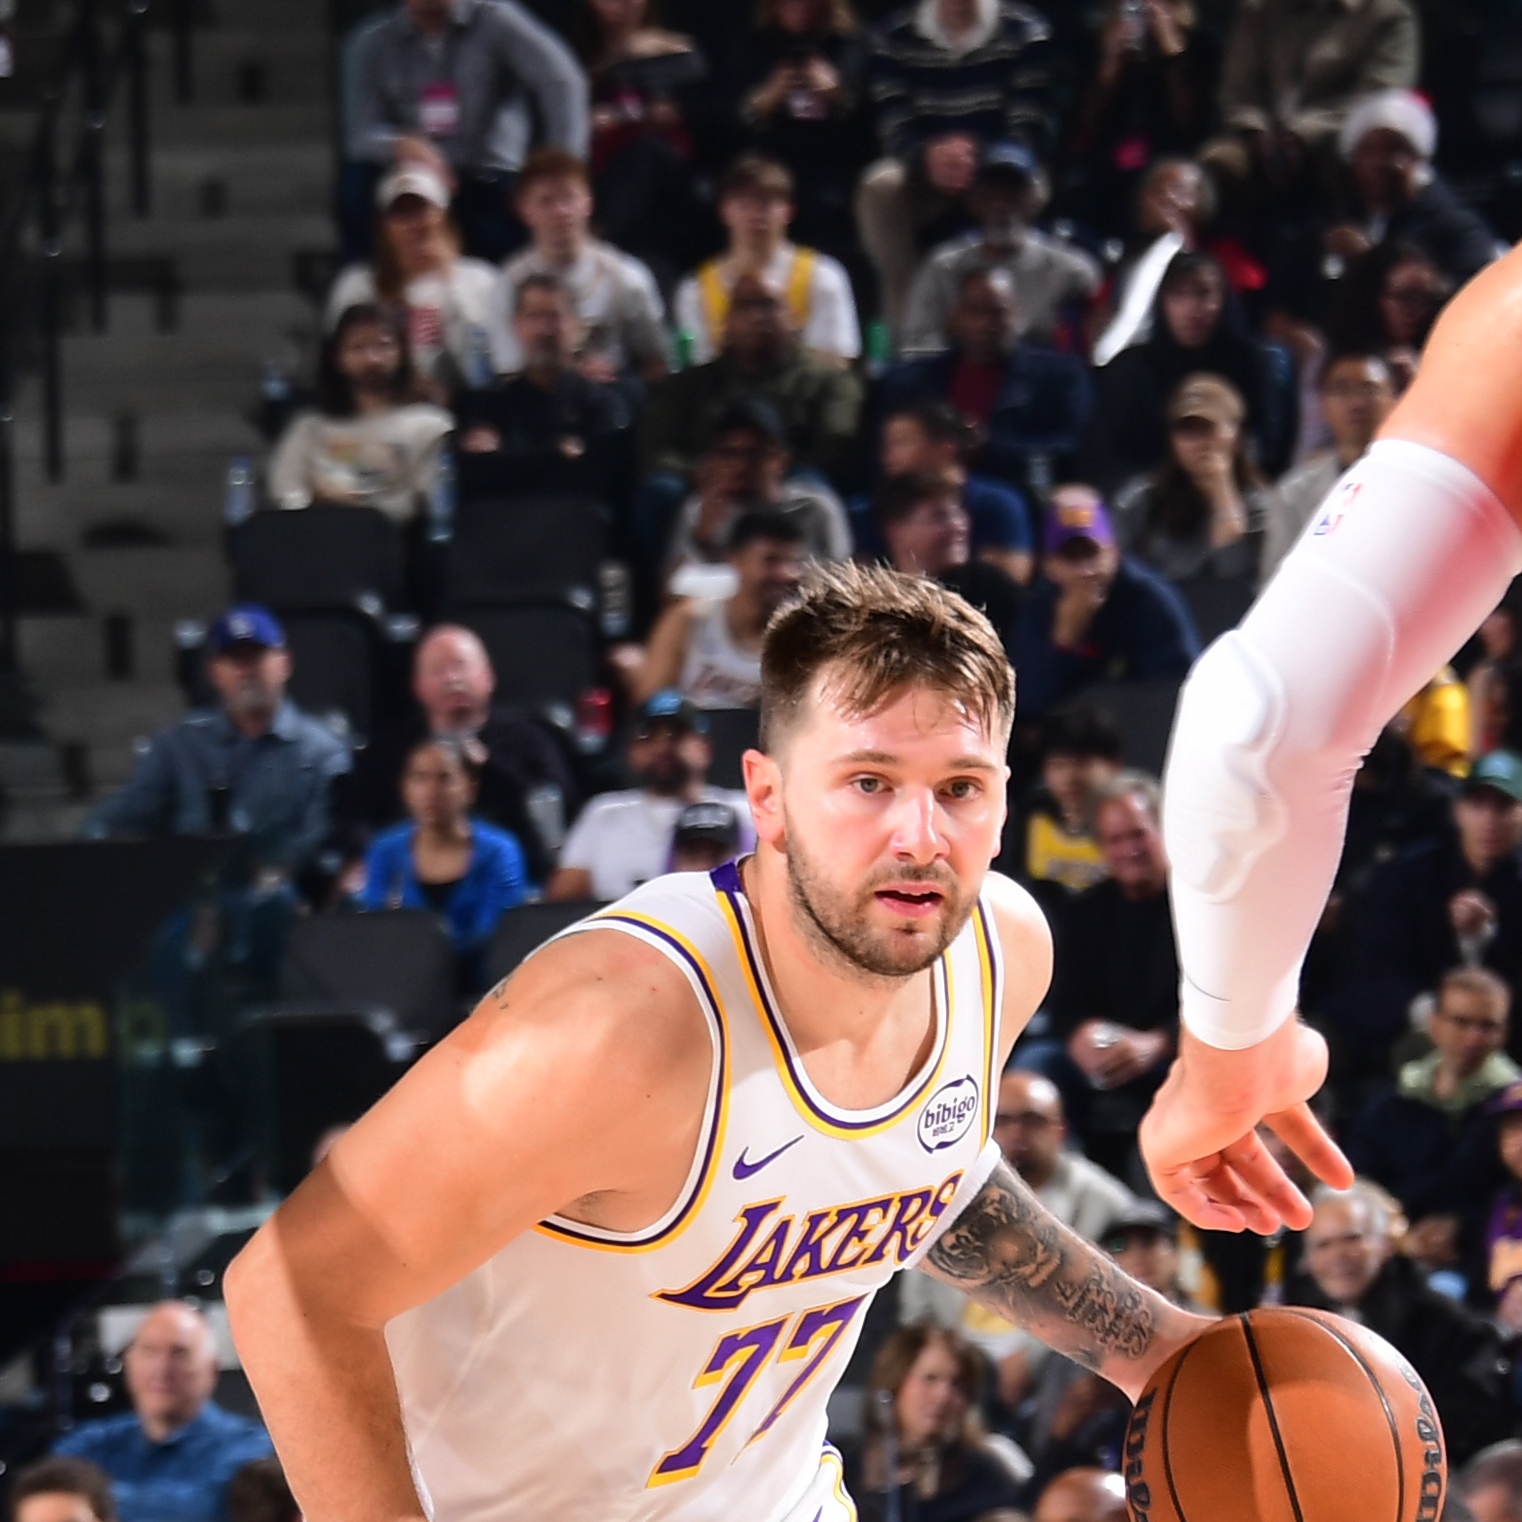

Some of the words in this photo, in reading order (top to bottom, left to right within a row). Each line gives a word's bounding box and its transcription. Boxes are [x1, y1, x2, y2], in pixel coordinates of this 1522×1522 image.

[924, 1095, 976, 1129] bibigo
[648, 1168, 966, 1314] LAKERS
[645, 1292, 872, 1490] 77
